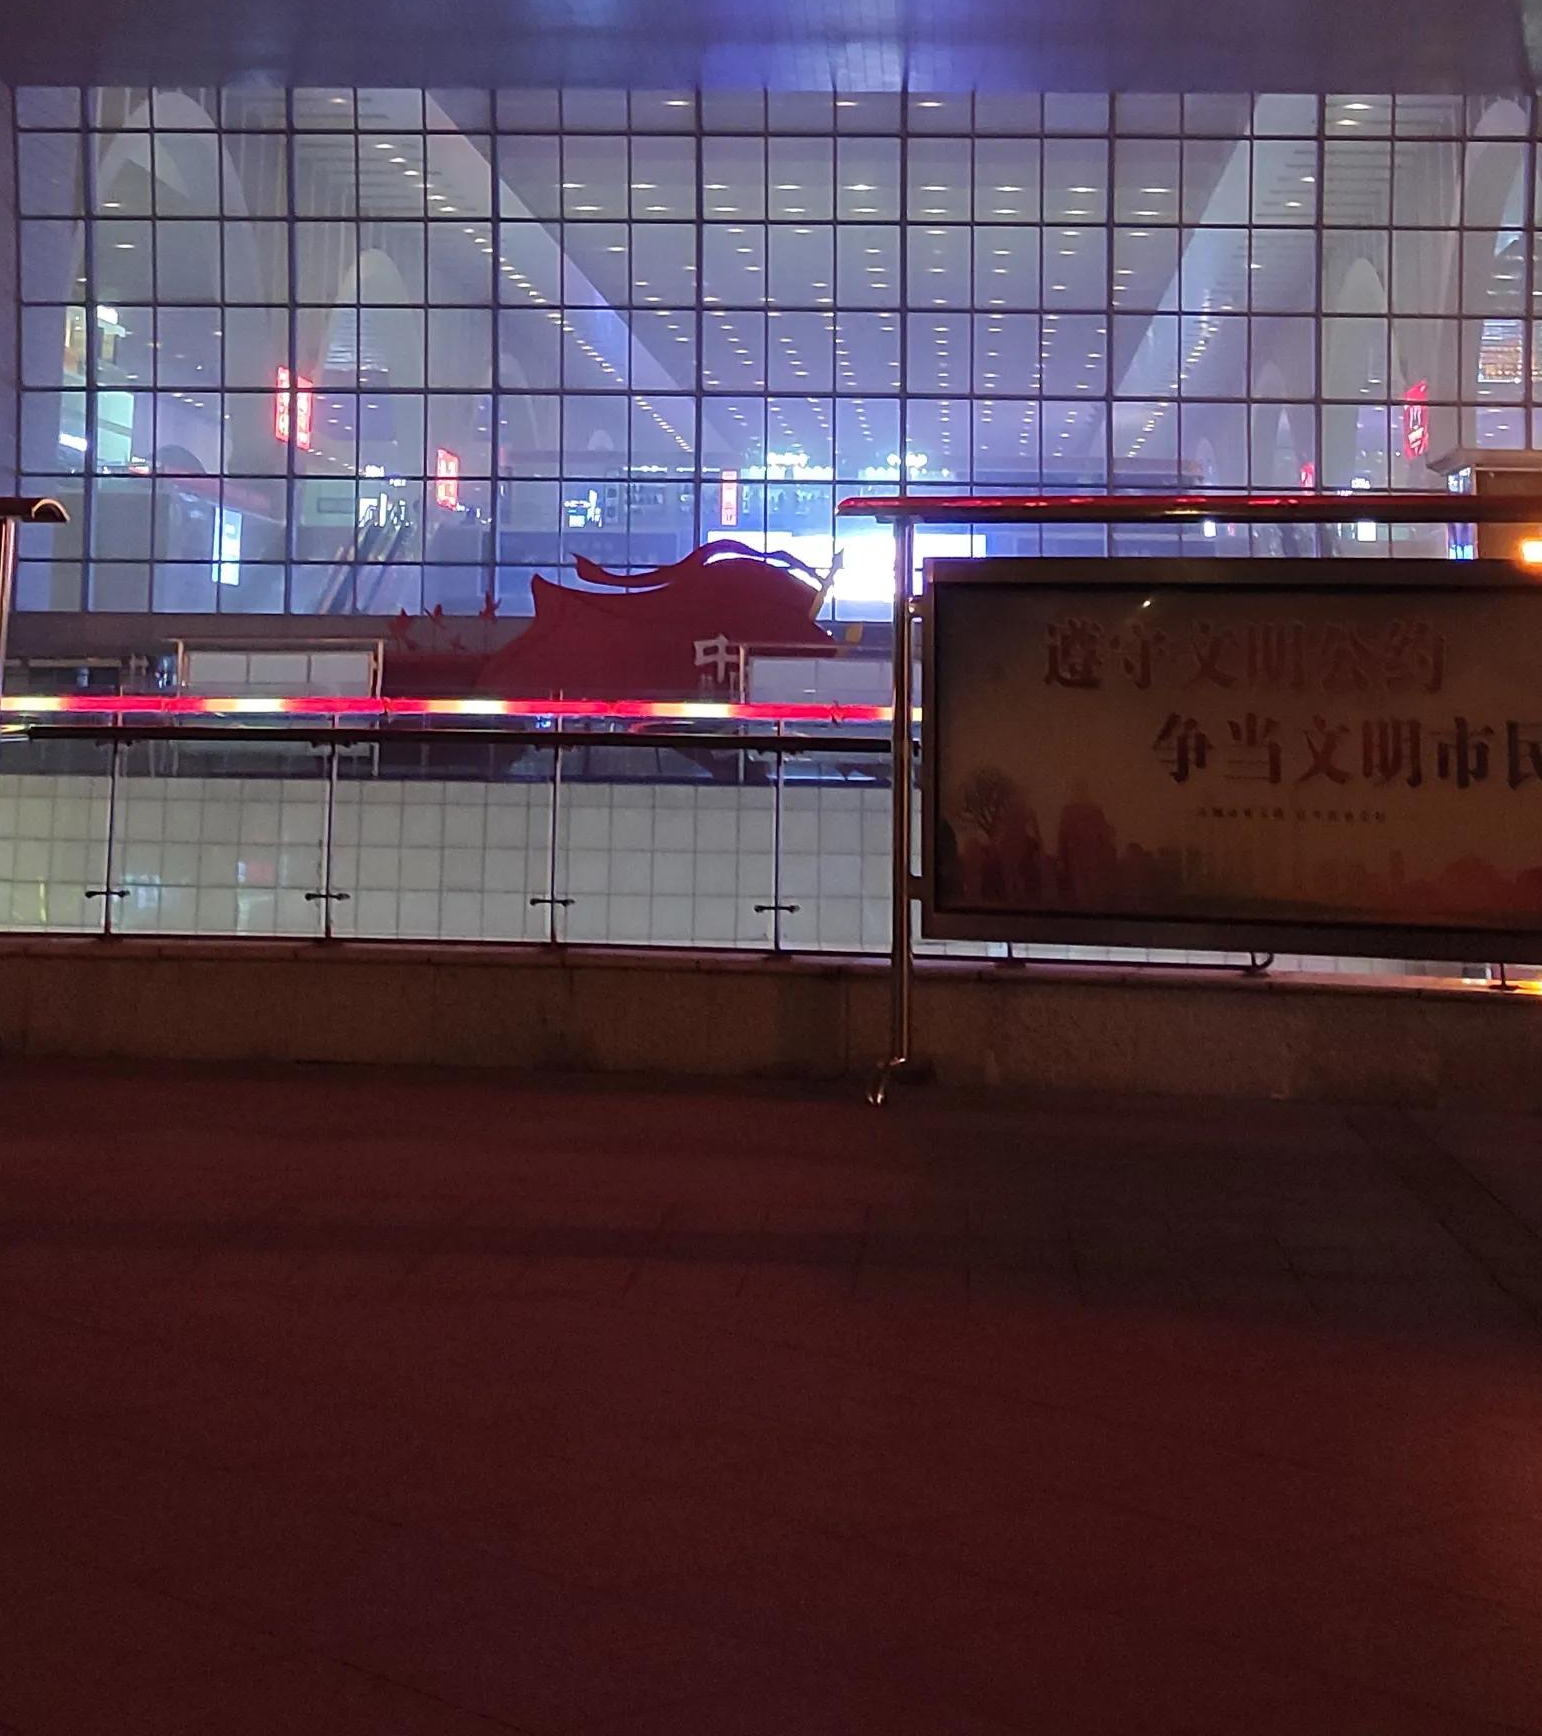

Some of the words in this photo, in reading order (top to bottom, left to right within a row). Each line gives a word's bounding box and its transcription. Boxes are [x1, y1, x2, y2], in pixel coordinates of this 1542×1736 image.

[1044, 616, 1450, 694] 遵守文明公约
